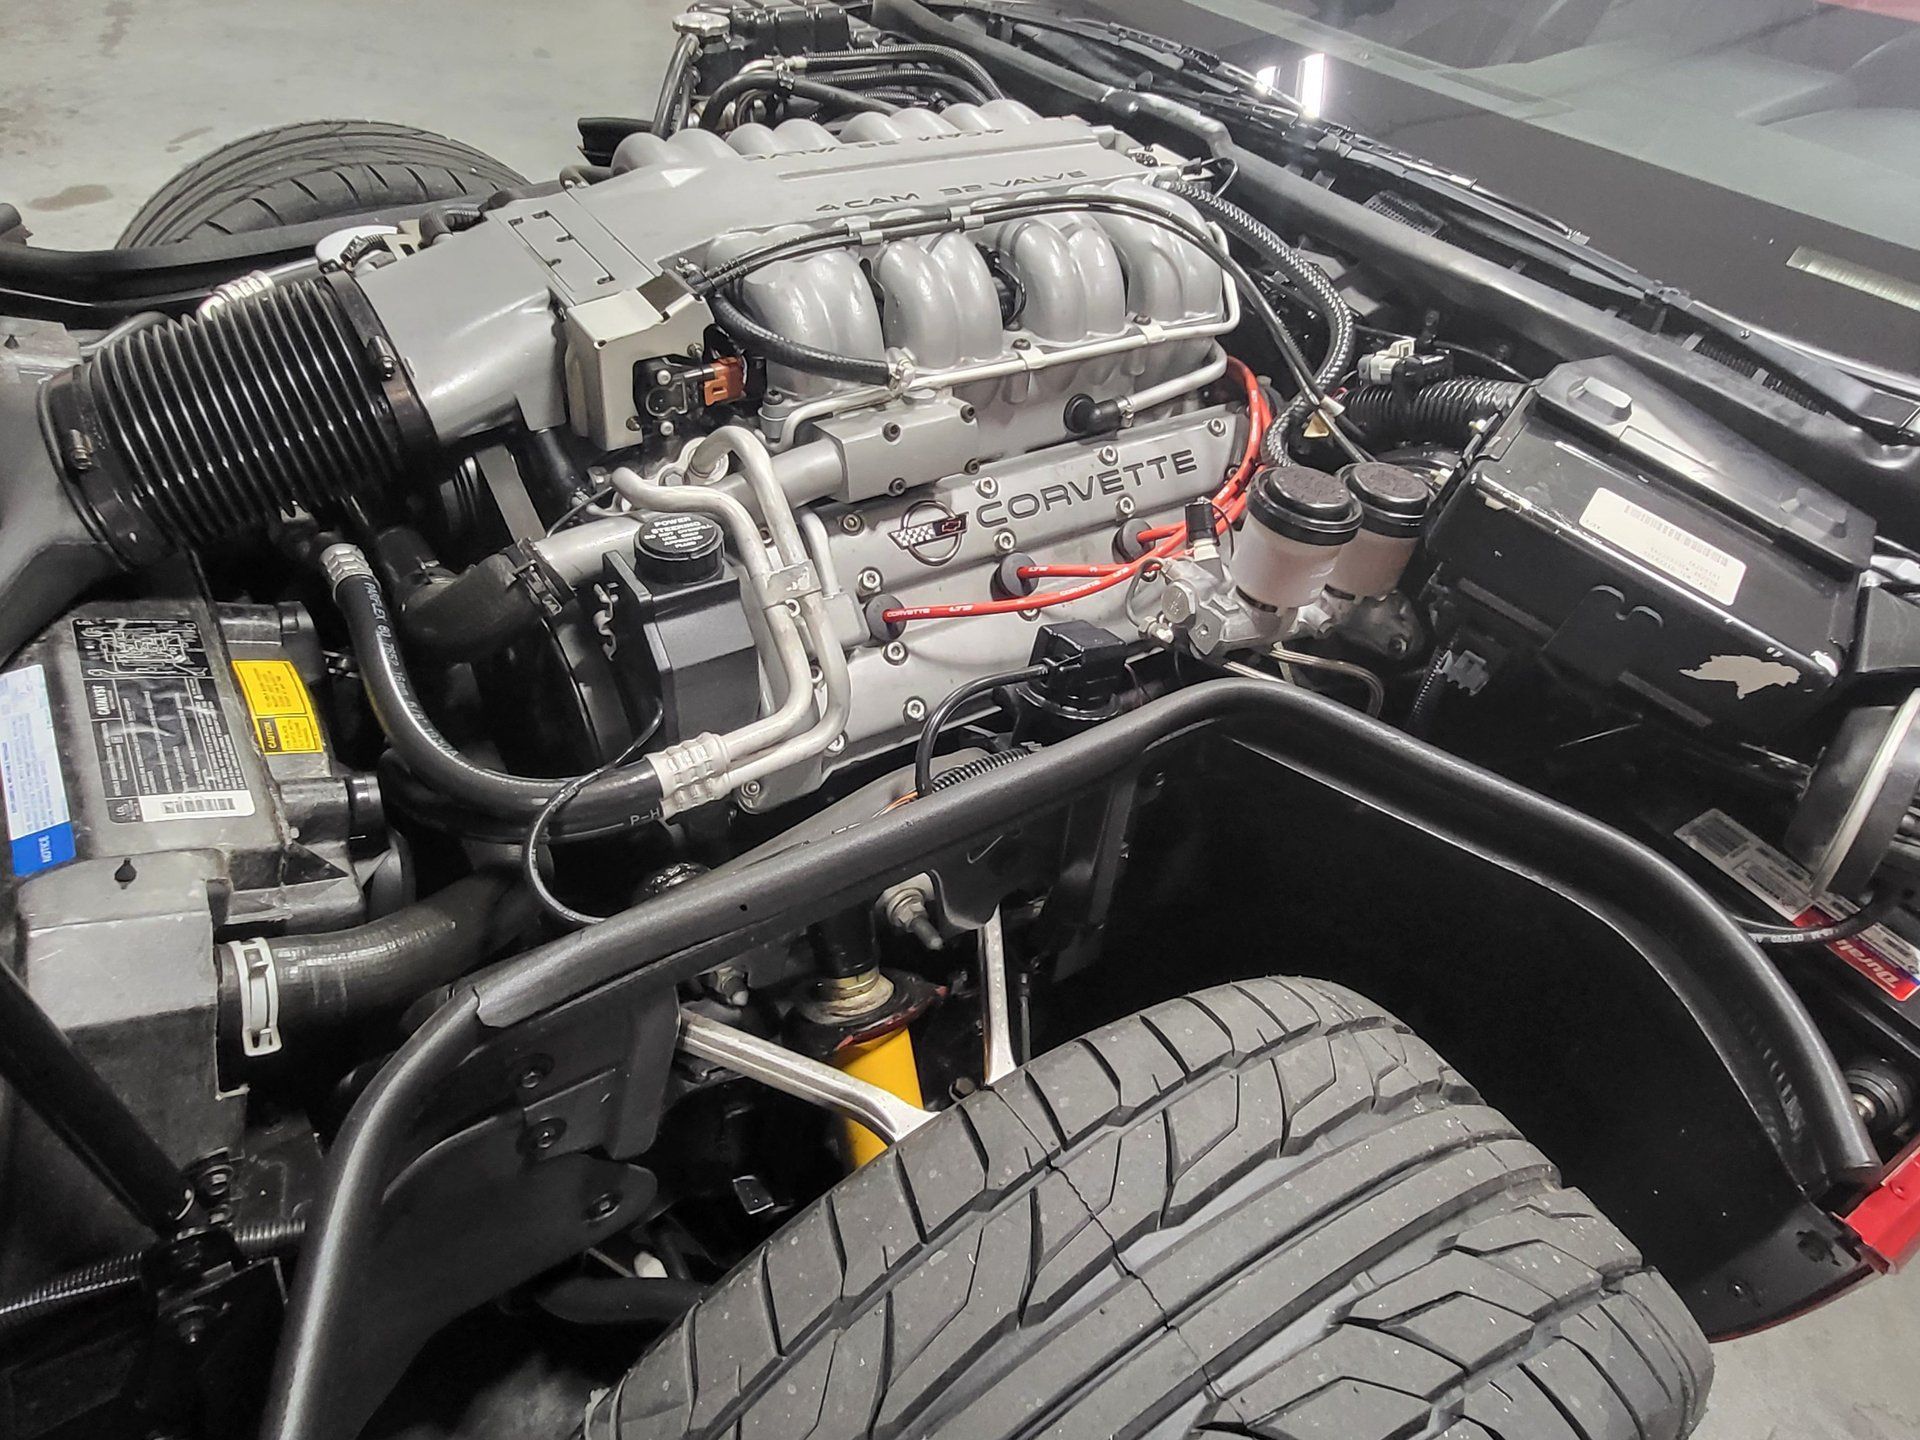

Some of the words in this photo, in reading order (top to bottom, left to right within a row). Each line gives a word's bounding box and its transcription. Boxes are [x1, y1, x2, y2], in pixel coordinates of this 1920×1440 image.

[938, 184, 984, 196] 32
[988, 169, 1089, 189] VALVE
[976, 448, 1198, 529] CORVETTE
[650, 521, 702, 535] STEERING
[653, 516, 692, 528] POWER
[364, 582, 388, 622] PARFLEX
[92, 684, 111, 716] CATALYST
[262, 720, 278, 750] CAUTION
[37, 834, 53, 864] NOTICE
[1834, 938, 1901, 990] Dural
